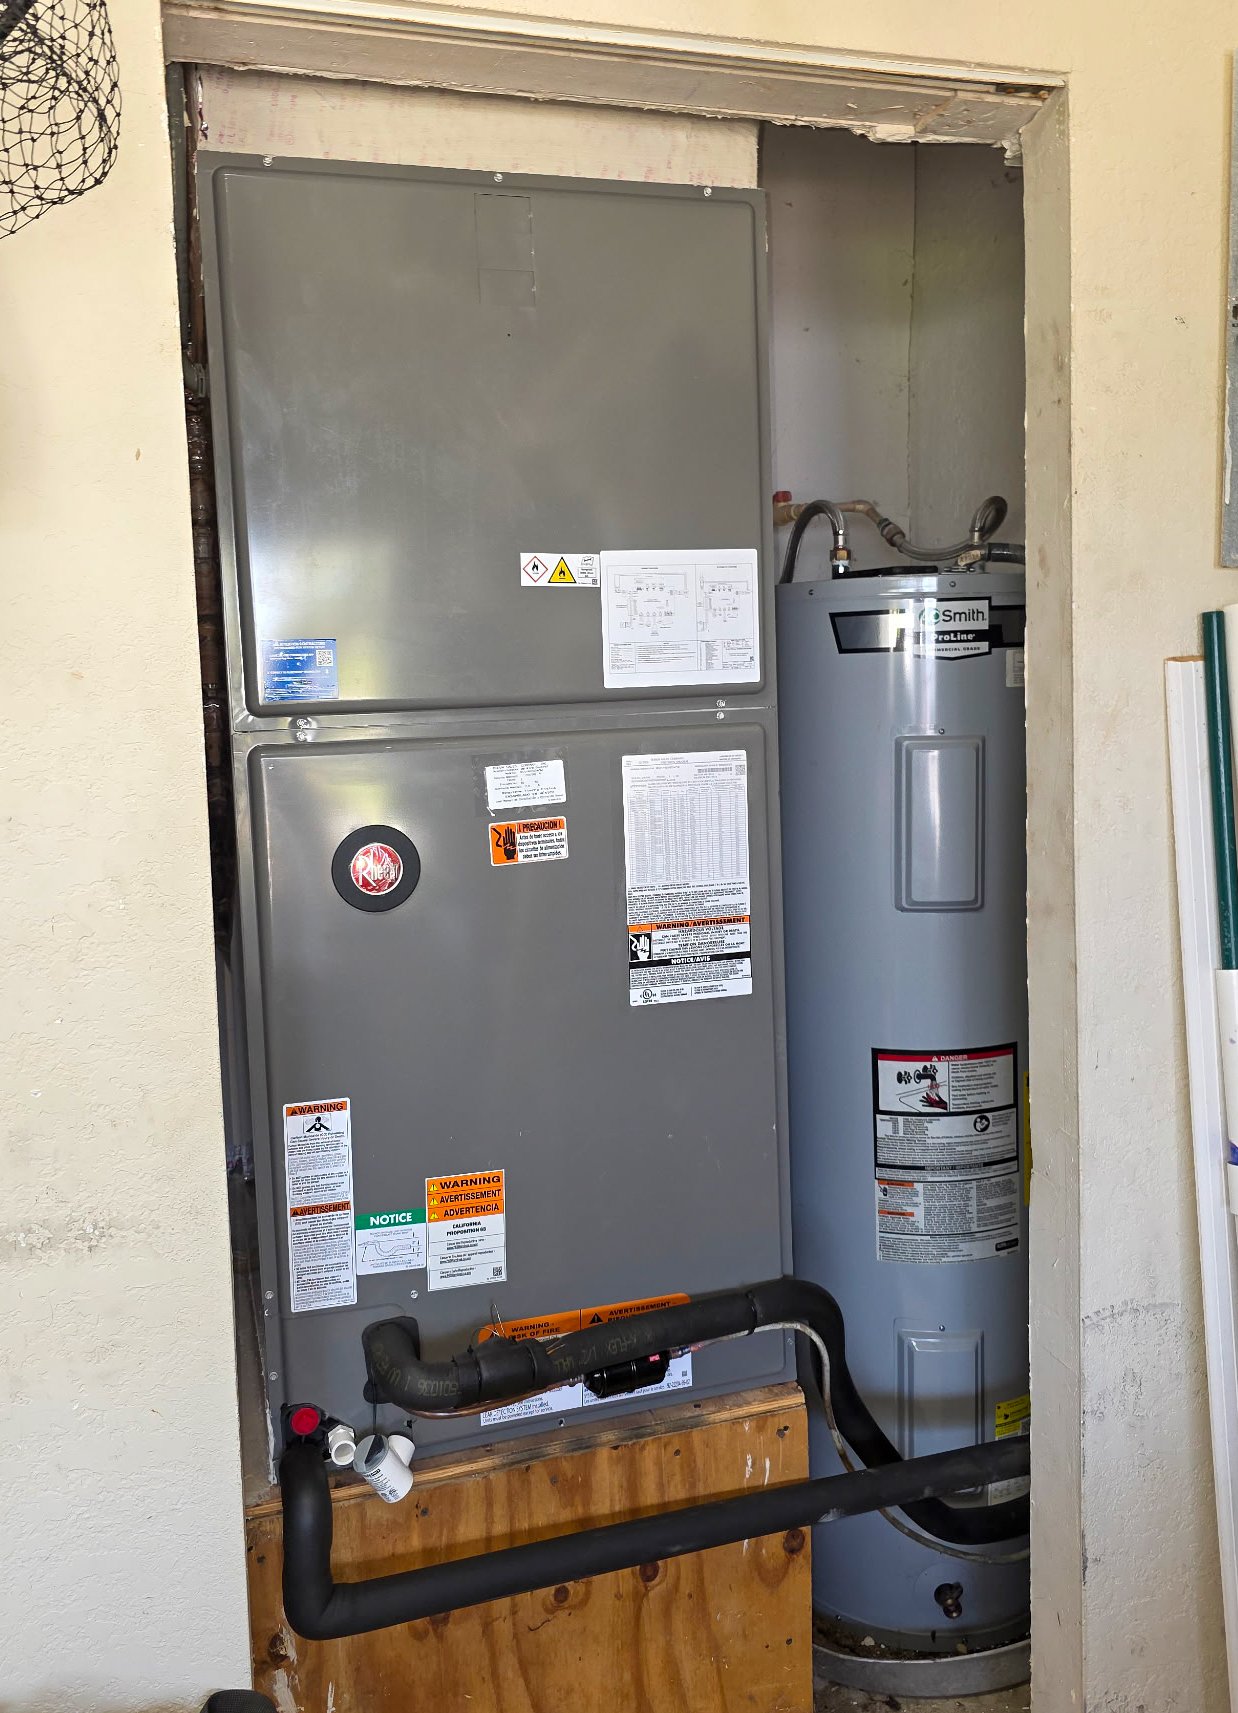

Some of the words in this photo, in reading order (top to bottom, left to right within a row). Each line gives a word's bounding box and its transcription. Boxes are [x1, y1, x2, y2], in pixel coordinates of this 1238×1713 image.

[942, 608, 984, 622] Smith
[355, 848, 399, 887] Rheem
[298, 1102, 343, 1113] WARNING
[440, 1175, 500, 1189] WARNING
[440, 1189, 501, 1204] AVERTISSEMENT
[300, 1202, 350, 1216] AVERTISSEMENT
[444, 1203, 499, 1217] ADVERTENCIA
[370, 1213, 412, 1226] NOTICE
[609, 1302, 670, 1316] AVERTISSEMENT
[512, 1322, 550, 1332] WARNING
[516, 1404, 532, 1412] SYSTEM
